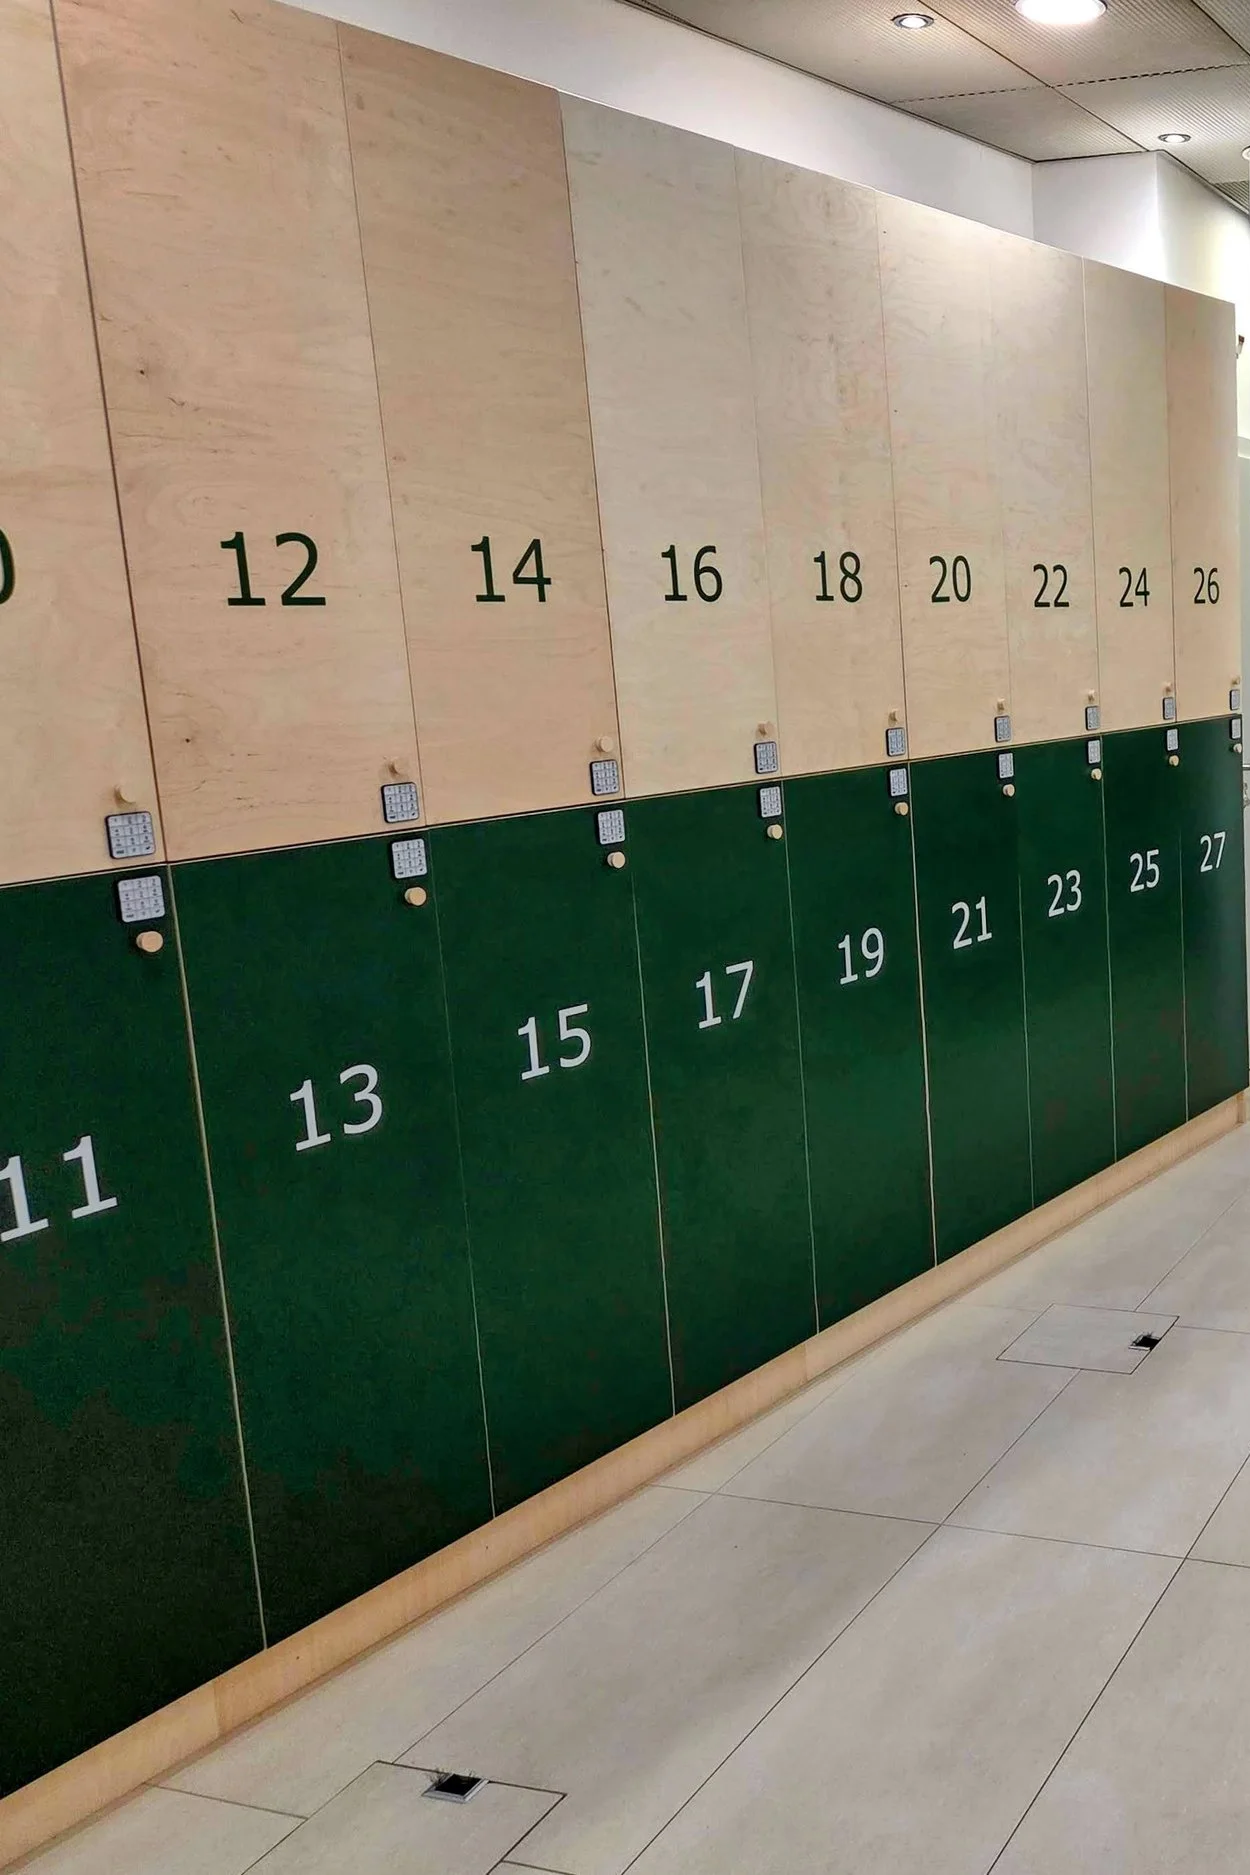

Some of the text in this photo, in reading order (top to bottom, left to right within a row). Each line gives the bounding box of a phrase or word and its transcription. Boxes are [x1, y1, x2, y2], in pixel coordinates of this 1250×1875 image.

[220, 531, 327, 607] 12
[470, 535, 552, 603] 14
[661, 544, 723, 603] 16
[813, 550, 863, 603] 18
[929, 555, 972, 603] 20
[1033, 563, 1070, 608] 22
[1118, 566, 1151, 608] 24
[1193, 567, 1220, 605] 26
[1129, 849, 1160, 893] 25
[1200, 831, 1226, 873] 27
[1047, 869, 1082, 918] 23
[951, 896, 993, 950] 21
[838, 927, 884, 985] 19
[695, 960, 754, 1029] 17
[517, 1003, 591, 1081] 15
[289, 1064, 383, 1151] 13
[0, 1135, 118, 1242] 11
